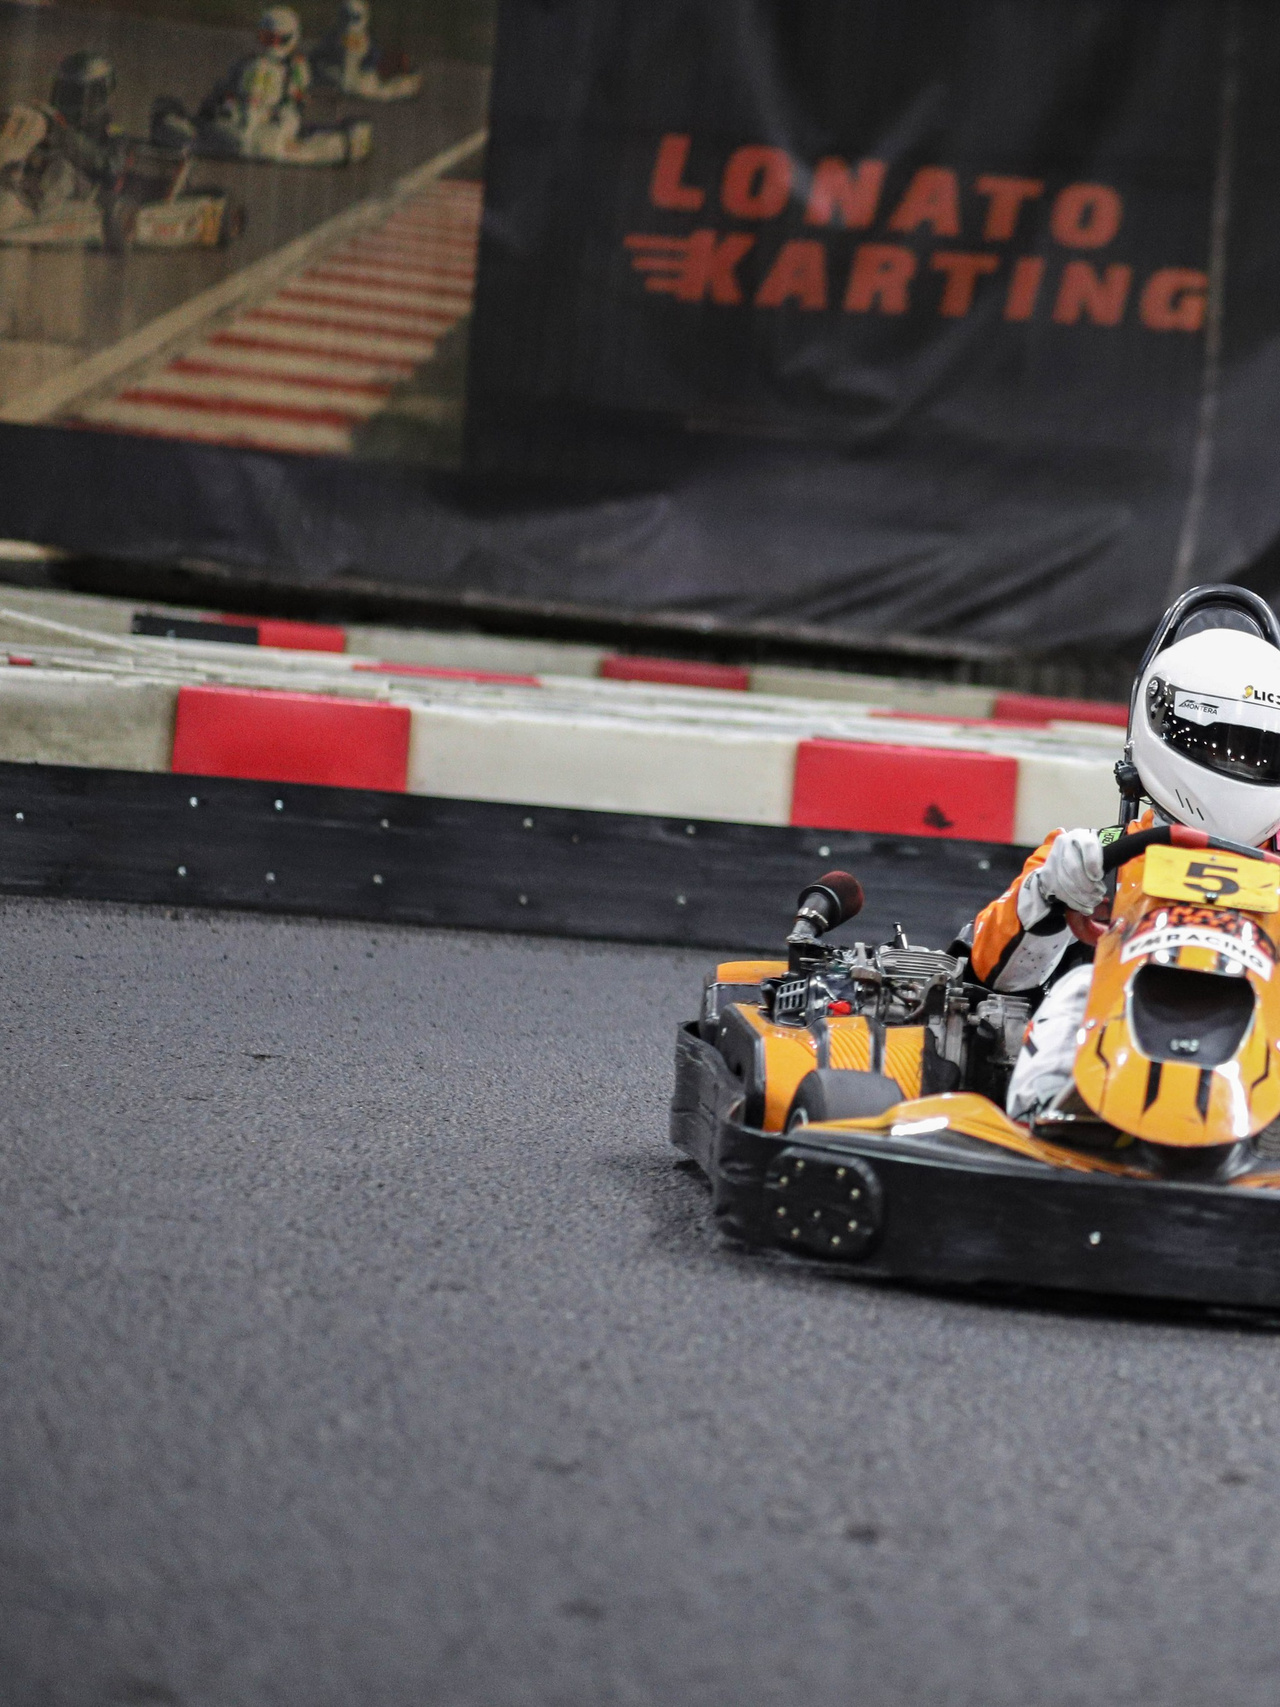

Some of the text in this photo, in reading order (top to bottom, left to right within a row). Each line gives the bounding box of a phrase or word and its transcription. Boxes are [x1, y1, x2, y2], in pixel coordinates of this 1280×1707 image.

[650, 132, 1124, 250] LONATO
[625, 228, 1209, 332] KARTING
[1183, 861, 1240, 896] 5
